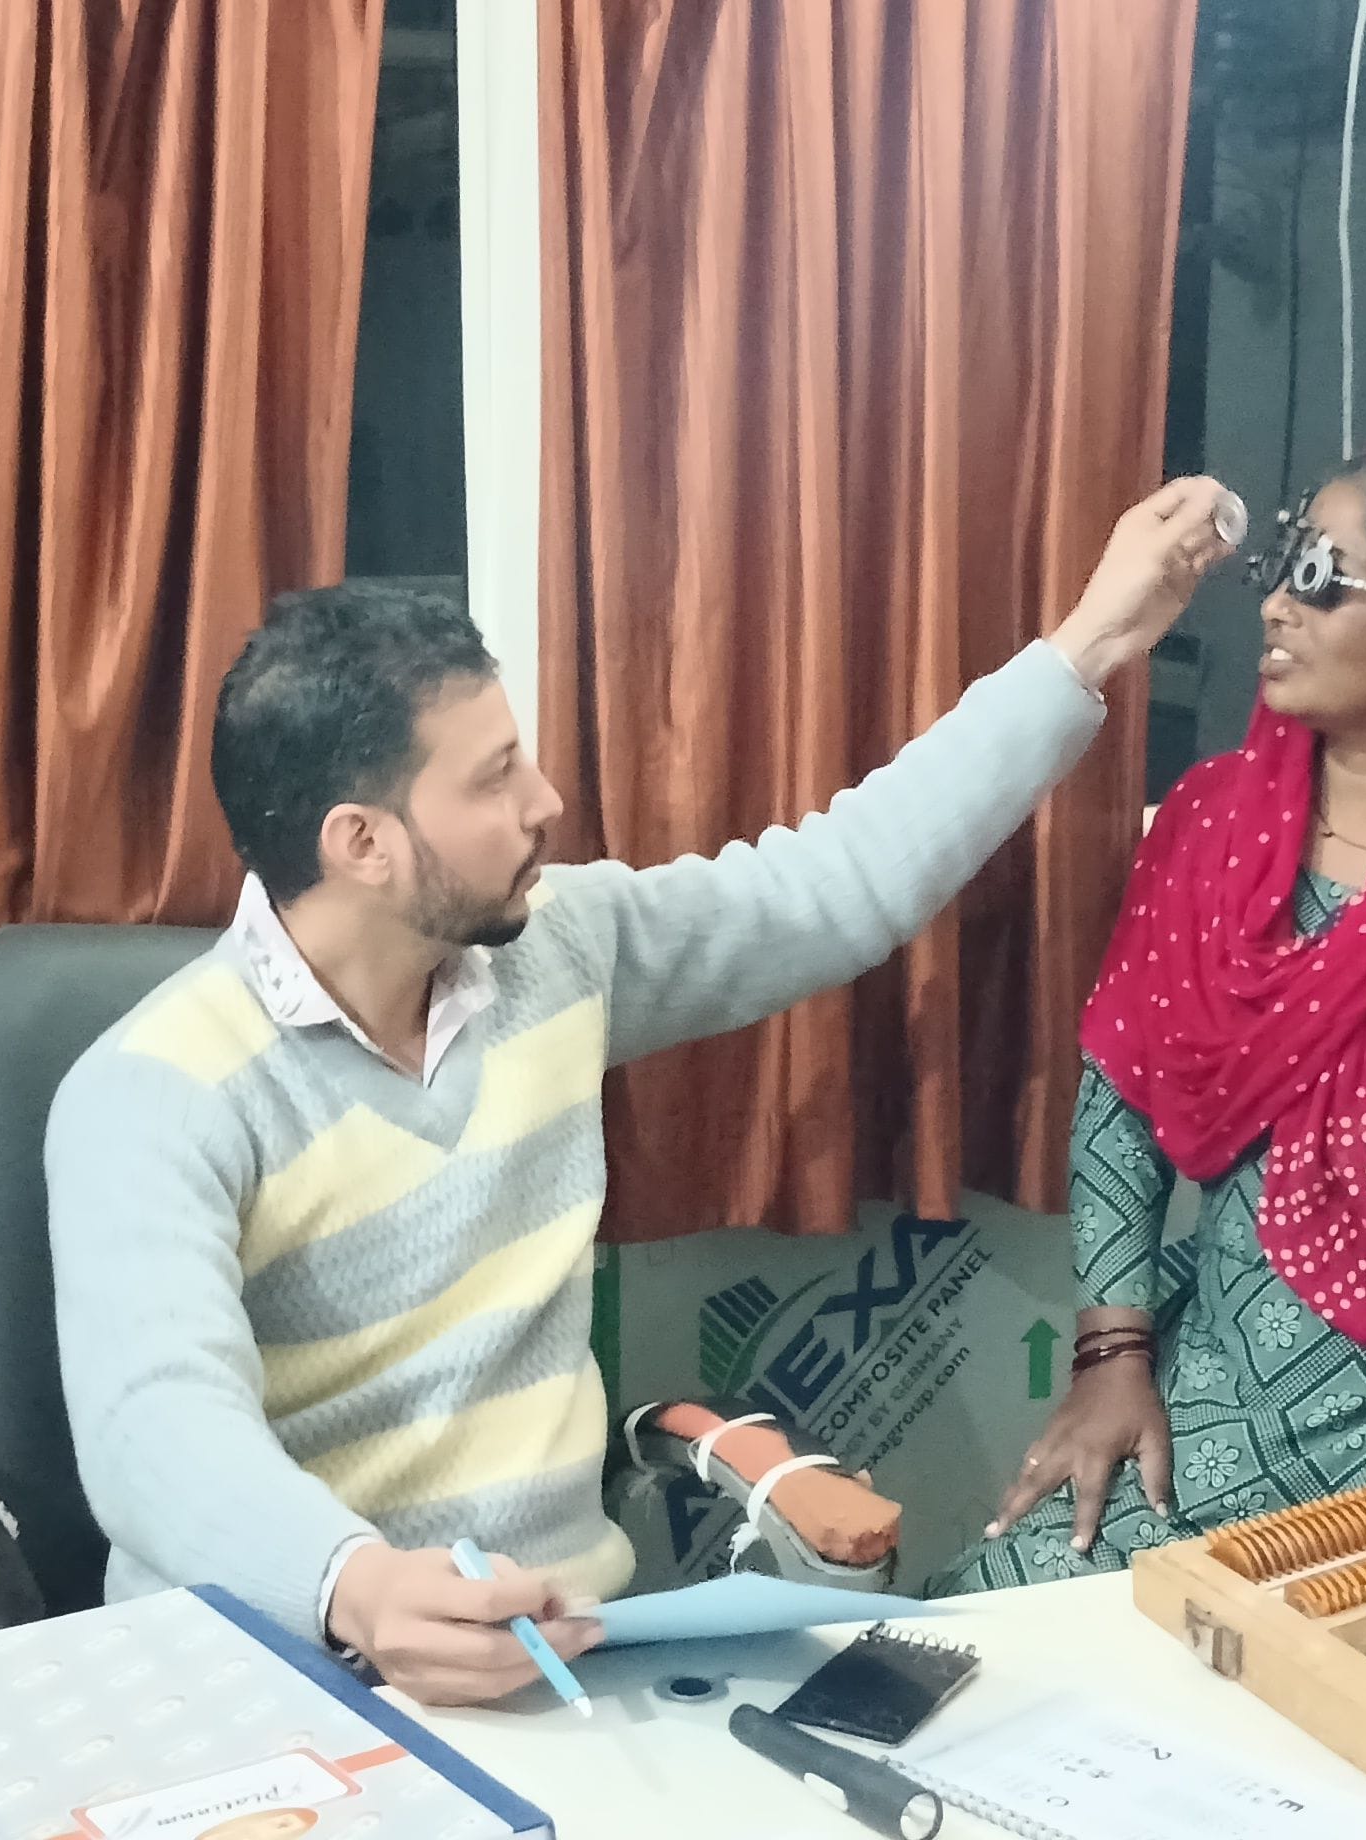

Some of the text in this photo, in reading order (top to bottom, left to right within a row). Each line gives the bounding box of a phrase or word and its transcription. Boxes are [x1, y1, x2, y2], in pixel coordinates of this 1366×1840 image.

[818, 1247, 994, 1446] COMPOSITE PANEL
[859, 1346, 971, 1473] exagroup.com
